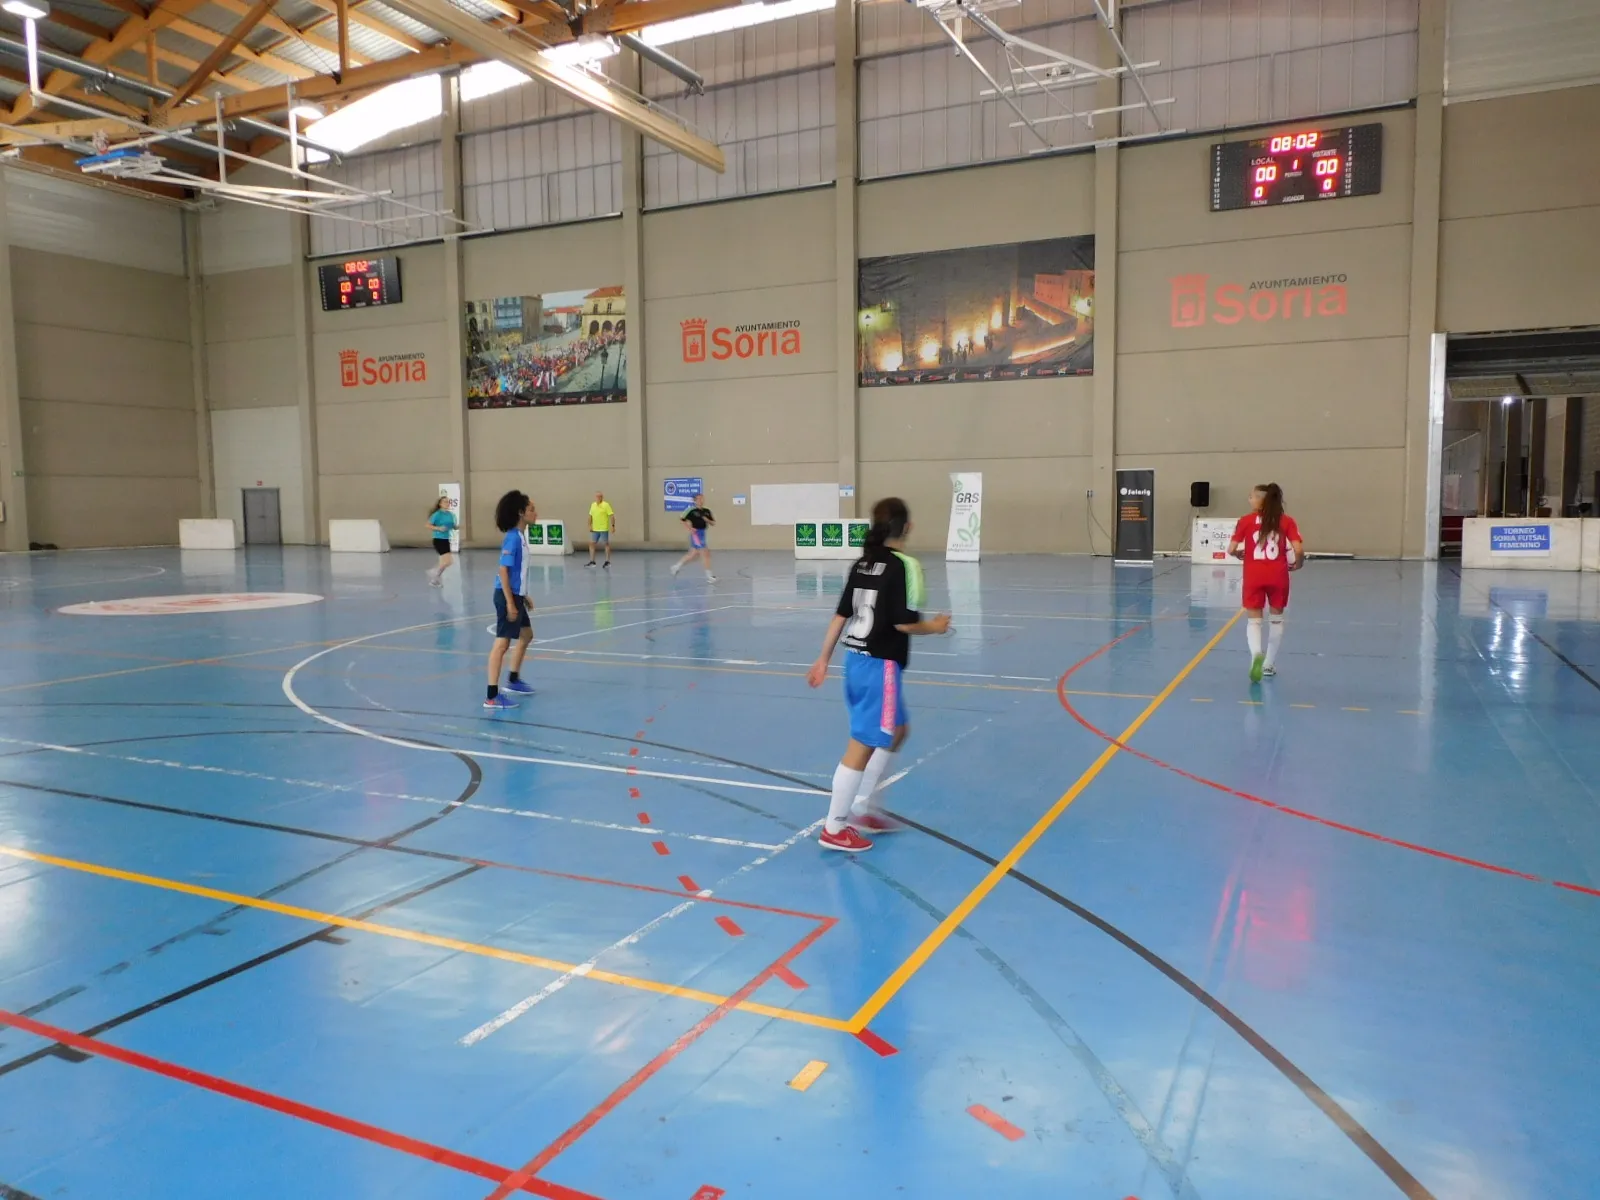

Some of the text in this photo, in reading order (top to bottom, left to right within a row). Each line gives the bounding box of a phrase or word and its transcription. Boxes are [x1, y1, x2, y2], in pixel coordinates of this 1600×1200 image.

[1270, 132, 1318, 153] 08:02
[1251, 157, 1275, 166] LOCAL
[1292, 159, 1299, 170] 1
[1315, 158, 1338, 176] 00
[1256, 166, 1277, 182] 00
[1323, 178, 1332, 190] 0
[1254, 186, 1263, 198] 0
[1249, 273, 1348, 290] AYUNTAMIENTO
[1212, 283, 1348, 326] Soria
[735, 319, 801, 332] AYUNTAMIENTO
[711, 327, 801, 360] Soria
[378, 352, 425, 362] AYUNTAMIENTO
[362, 357, 426, 385] Soria
[956, 492, 980, 503] GRS
[1503, 527, 1536, 535] TORNEO
[1493, 534, 1516, 542] SORIA
